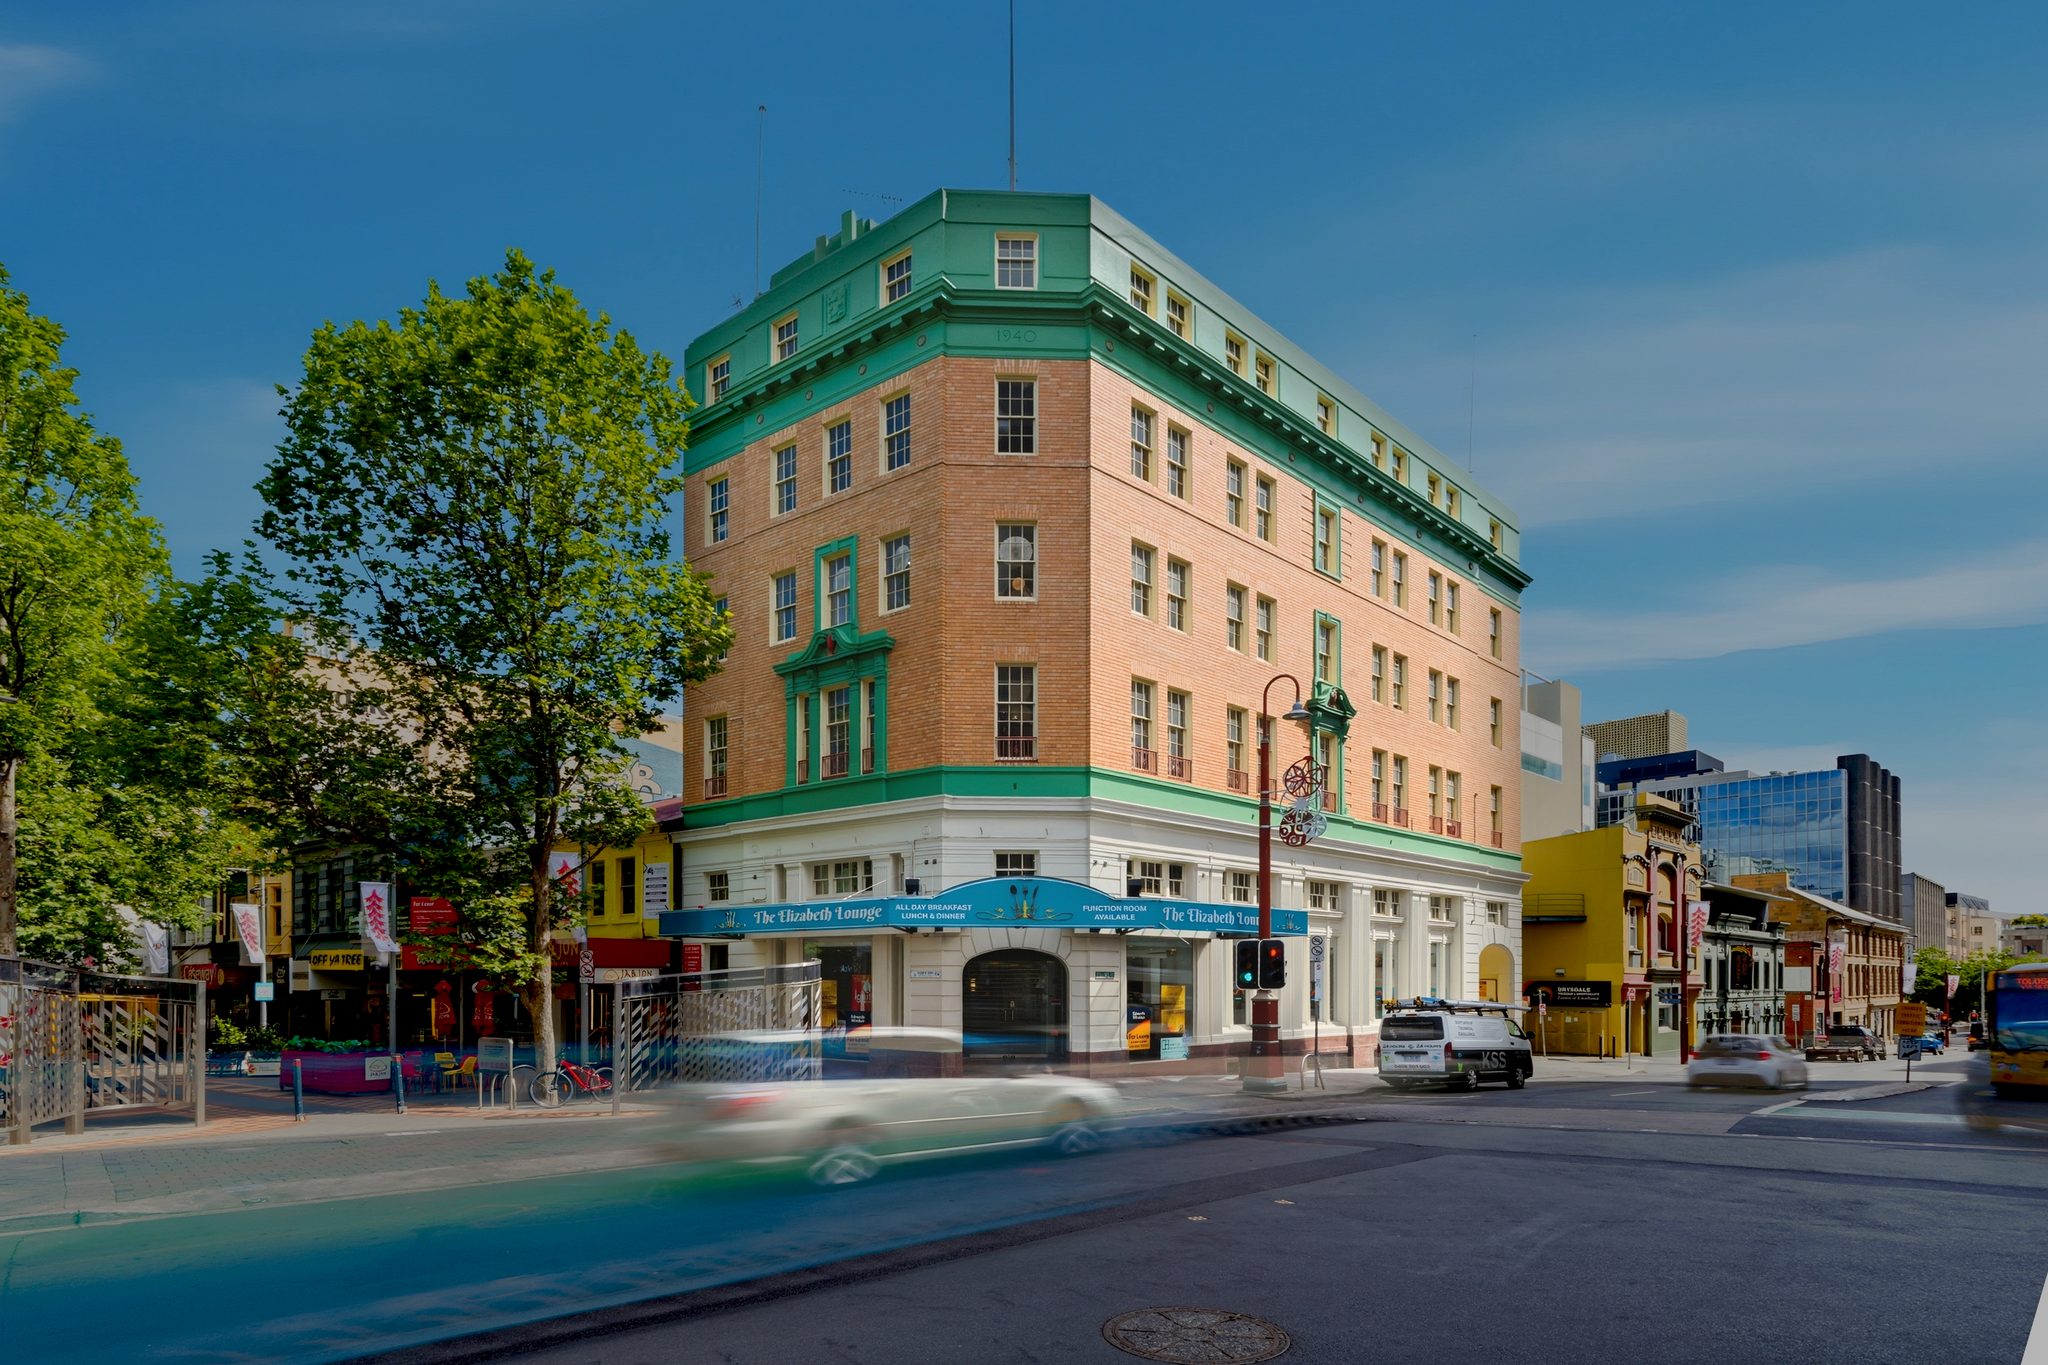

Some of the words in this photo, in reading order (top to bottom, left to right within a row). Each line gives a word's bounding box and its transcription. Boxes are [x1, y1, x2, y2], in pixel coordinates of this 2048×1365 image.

[996, 328, 1037, 343] 1940
[753, 910, 776, 925] The
[777, 907, 832, 924] Elizabeth
[834, 905, 883, 923] Lounge
[936, 912, 966, 920] DINNER
[1162, 906, 1185, 922] The
[1186, 908, 1235, 926] Elizabeth
[312, 954, 328, 965] OFF
[341, 954, 362, 965] TREE
[1482, 1051, 1506, 1068] KSS
